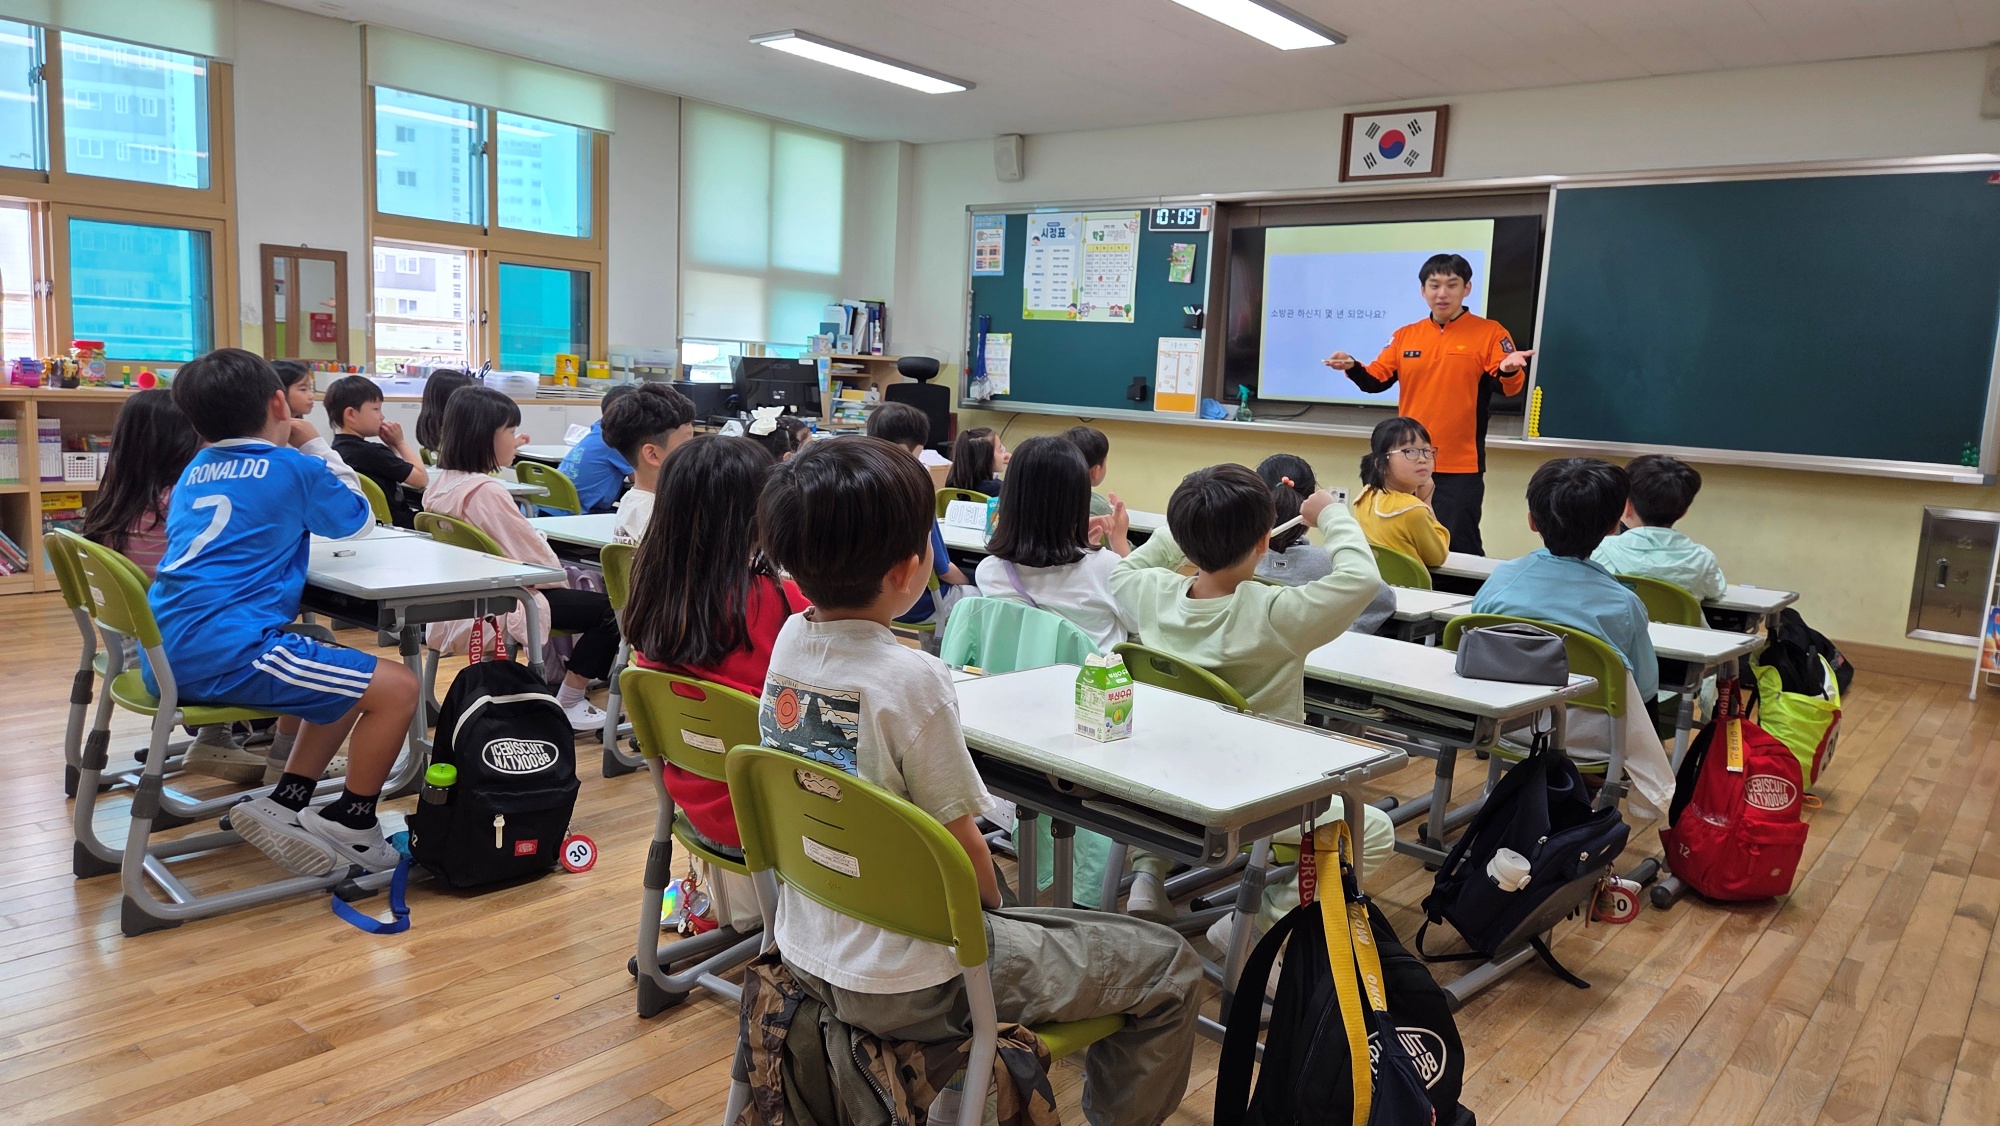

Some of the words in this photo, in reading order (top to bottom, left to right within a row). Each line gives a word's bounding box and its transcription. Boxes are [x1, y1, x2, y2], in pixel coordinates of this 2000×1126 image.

[1156, 208, 1196, 225] 10:09
[1041, 227, 1066, 239] 시정표
[1270, 309, 1294, 319] 소방관
[1297, 308, 1321, 319] 하신지
[1325, 308, 1333, 319] 몇
[1336, 308, 1344, 319] 년
[1347, 308, 1387, 319] 되었나요?
[185, 458, 270, 486] RONALDO
[161, 494, 232, 572] 7
[471, 630, 481, 665] BROO
[490, 740, 545, 756] ICEBISCUIT
[493, 752, 551, 771] BROOKLYN
[279, 783, 308, 801] NY
[347, 802, 374, 816] NY
[569, 844, 588, 863] 30
